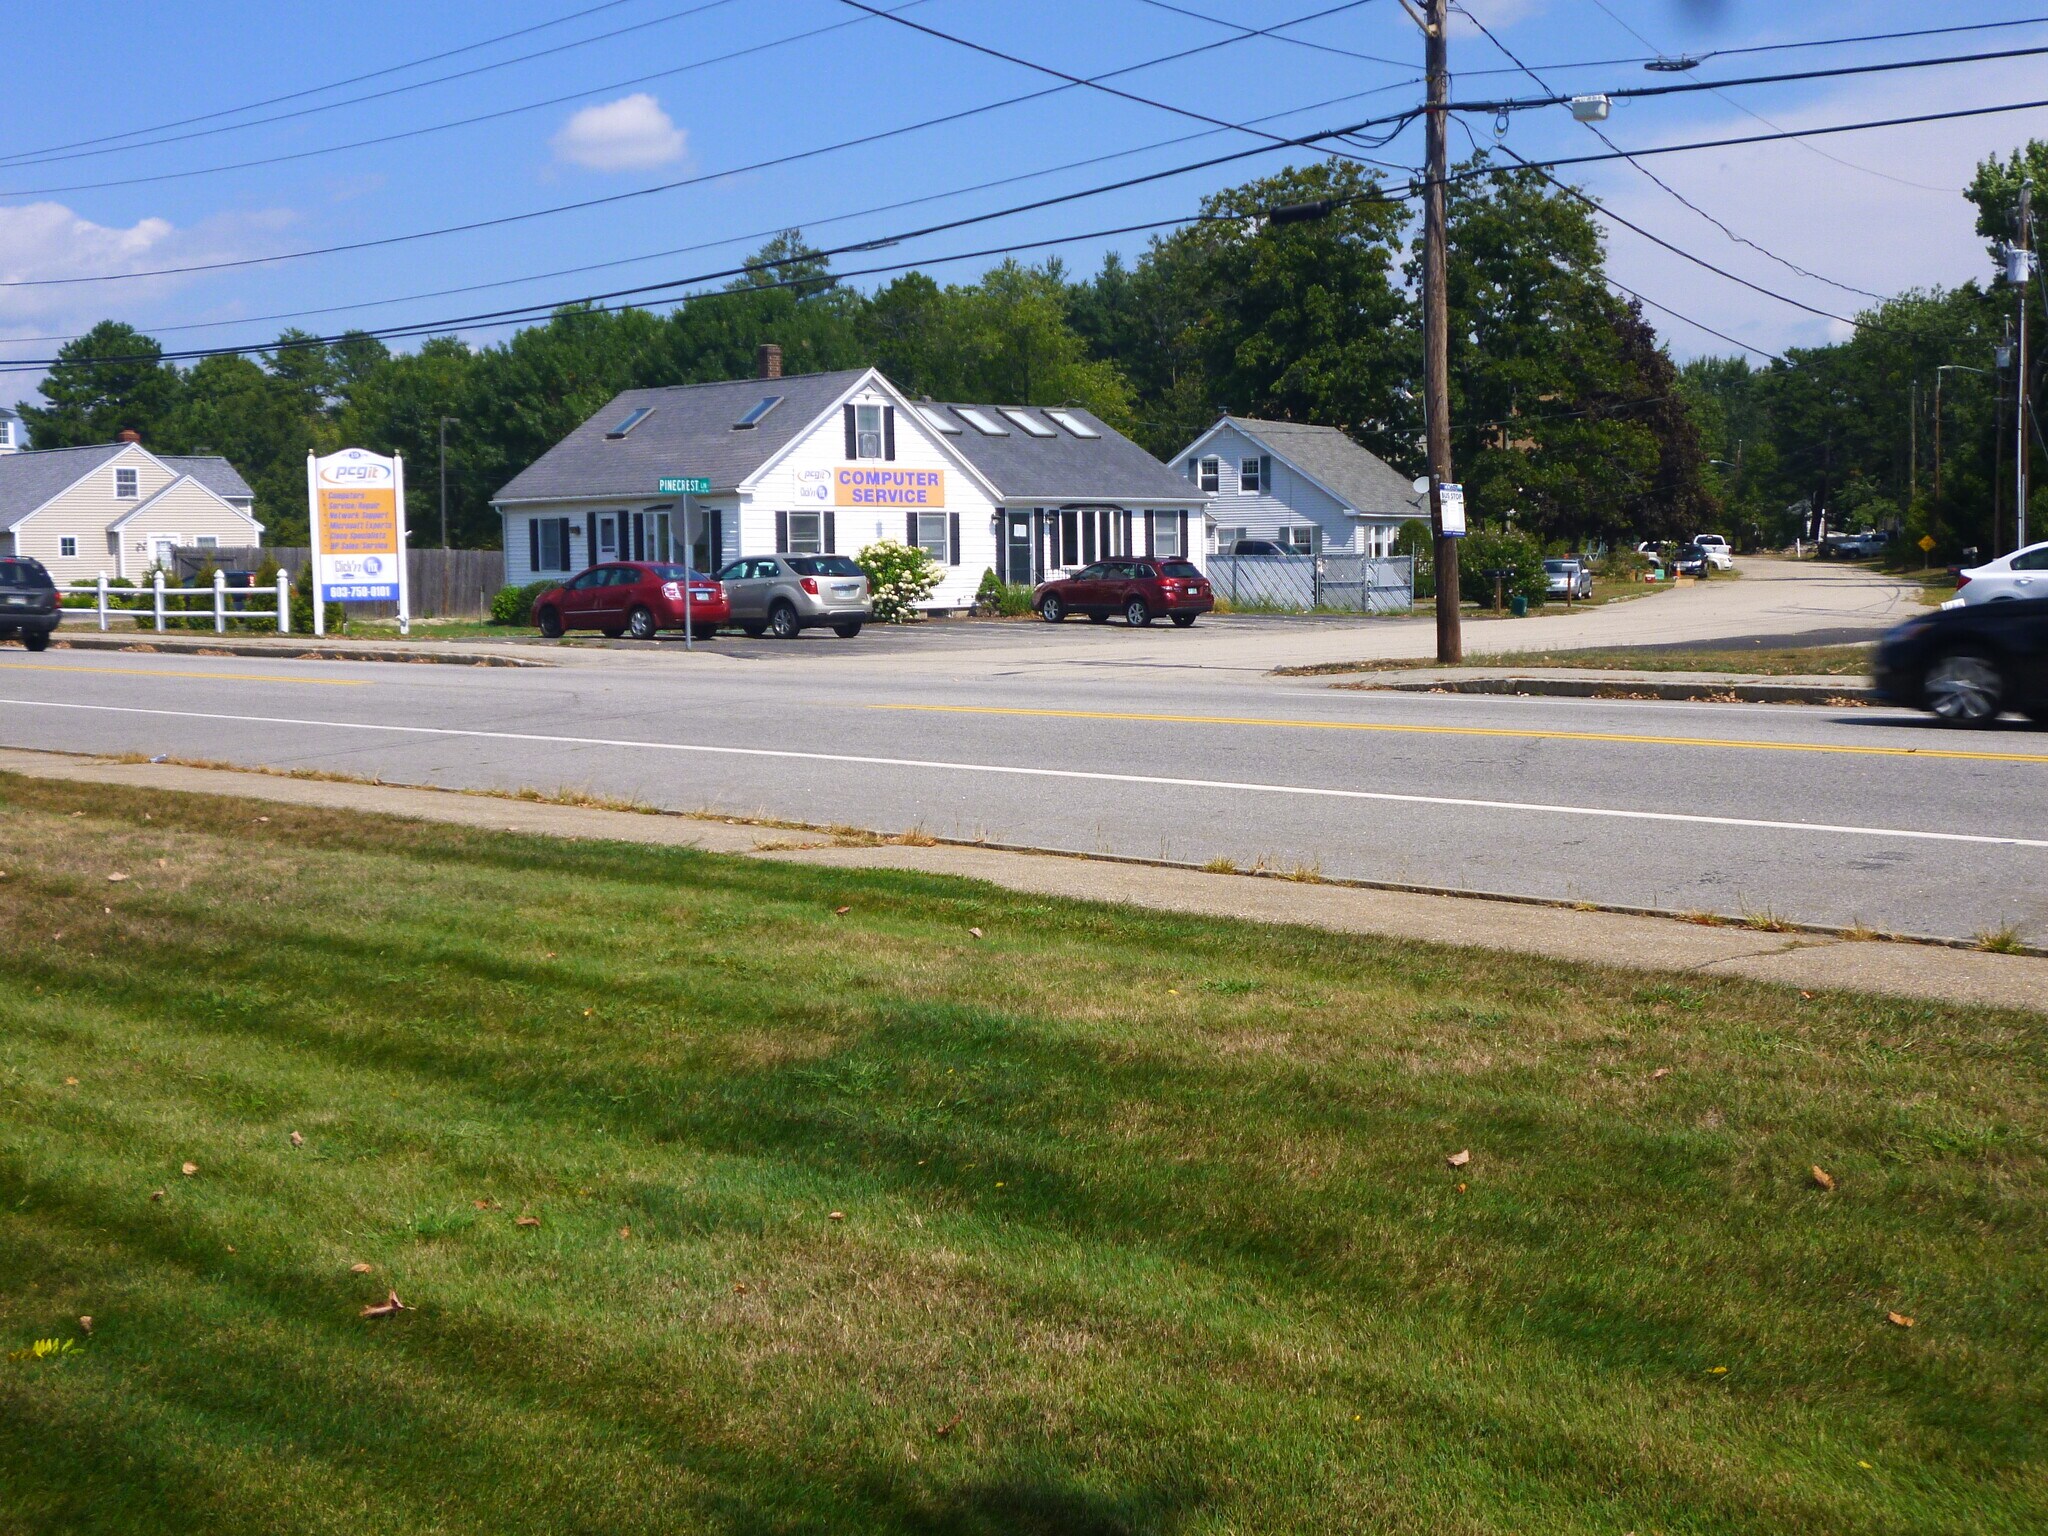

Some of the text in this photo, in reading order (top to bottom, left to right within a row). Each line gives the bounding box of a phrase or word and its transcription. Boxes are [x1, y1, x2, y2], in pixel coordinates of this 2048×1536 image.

[660, 479, 699, 491] PINECREST
[839, 471, 939, 486] COMPUTER
[852, 489, 927, 503] SERVICE
[1451, 493, 1462, 501] STOP
